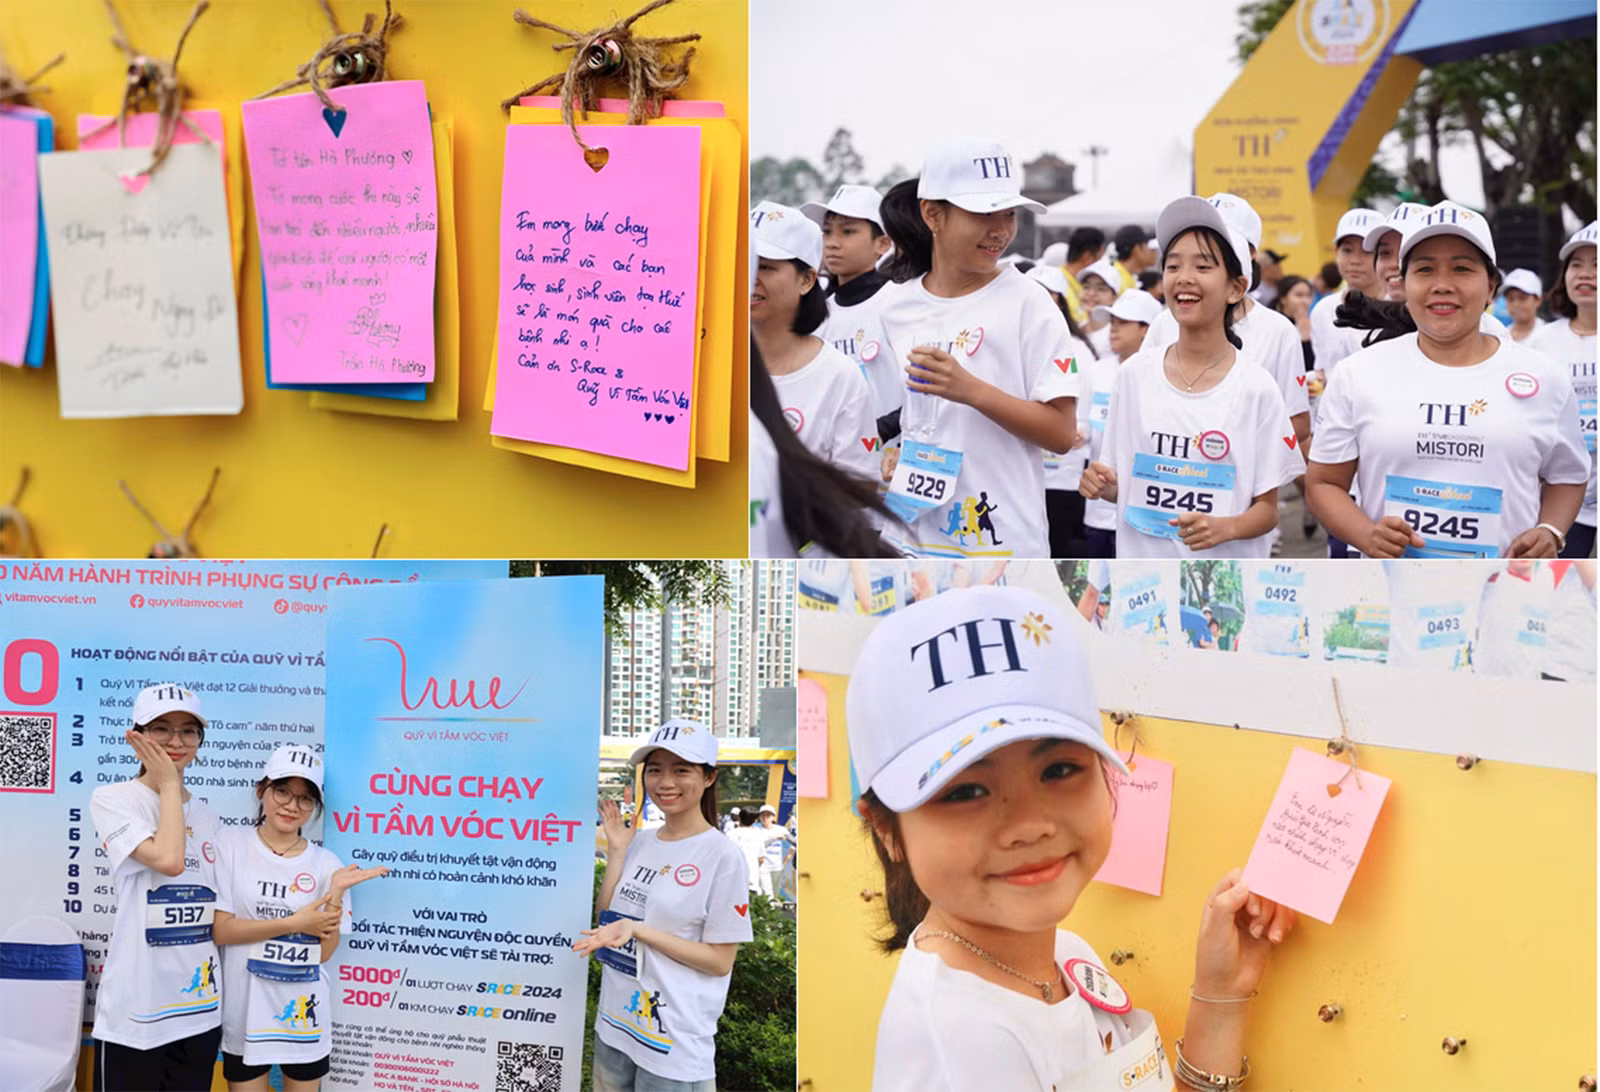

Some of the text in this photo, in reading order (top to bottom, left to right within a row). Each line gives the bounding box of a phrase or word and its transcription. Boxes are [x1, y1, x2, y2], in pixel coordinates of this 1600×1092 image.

[973, 157, 1011, 179] TH
[516, 210, 537, 232] Em
[542, 247, 571, 264] mình
[579, 255, 595, 268] và
[641, 259, 665, 278] bạn
[1419, 402, 1469, 427] TH
[1151, 431, 1192, 460] TH
[1416, 440, 1485, 458] MISTORI
[906, 472, 946, 500] 9229
[1146, 485, 1214, 514] 9245
[1404, 509, 1479, 540] 9245
[12, 562, 64, 582] NĂM
[69, 562, 131, 584] HÀNH
[135, 566, 202, 587] TRÌNH
[207, 571, 285, 590] PHỤNG
[289, 573, 318, 593] SỰ
[5, 592, 97, 605] vitamvocviet.vn
[147, 597, 244, 609] quyvitamvocviet
[1128, 589, 1158, 610] 0491
[1264, 586, 1297, 602] 0492
[1427, 617, 1460, 634] 0493
[71, 648, 112, 661] HOẠT
[114, 647, 156, 662] ĐỘNG
[188, 649, 218, 664] BẬT
[221, 649, 249, 664] CỦA
[253, 651, 284, 665] QUỸ
[288, 651, 302, 666] VÌ
[305, 651, 325, 667] TẦ
[911, 617, 1029, 693] TH
[225, 682, 236, 692] 12
[72, 714, 85, 728] 2
[299, 723, 315, 734] hai
[71, 733, 84, 747] 3
[464, 730, 487, 742] VÓC
[288, 750, 314, 768] TH
[69, 771, 84, 785] 4
[369, 767, 544, 803] CÙNG CHẠY
[69, 808, 82, 822] 5
[333, 802, 582, 846] VÌ TẦM VÓC VIỆT
[69, 827, 81, 841] 6
[69, 846, 80, 860] 7
[352, 848, 557, 872] Gây quỹ điều trị khuyết tật vận động
[68, 864, 80, 878] 8
[403, 868, 421, 880] nhi
[422, 869, 436, 881] có
[438, 870, 468, 882] hoàn
[470, 870, 499, 884] cảnh
[501, 873, 524, 885] khó
[526, 873, 557, 888] khăn
[68, 882, 80, 896] 9
[257, 880, 288, 899] TH
[63, 900, 82, 913] 10
[164, 906, 205, 925] 5137
[412, 907, 488, 924] VỚI VAI TRÒ
[372, 922, 396, 935] TÁC
[398, 924, 436, 939] THIỆN
[437, 927, 492, 943] NGUYỆN
[494, 930, 522, 945] ĐỘC
[263, 943, 310, 962] 5144
[349, 938, 554, 966] QUỸ VÌ TẦM VÓC VIỆT SẼ TÀI TRỢ:
[522, 985, 562, 999] 2024
[410, 1003, 428, 1013] KM
[503, 1008, 557, 1023] online
